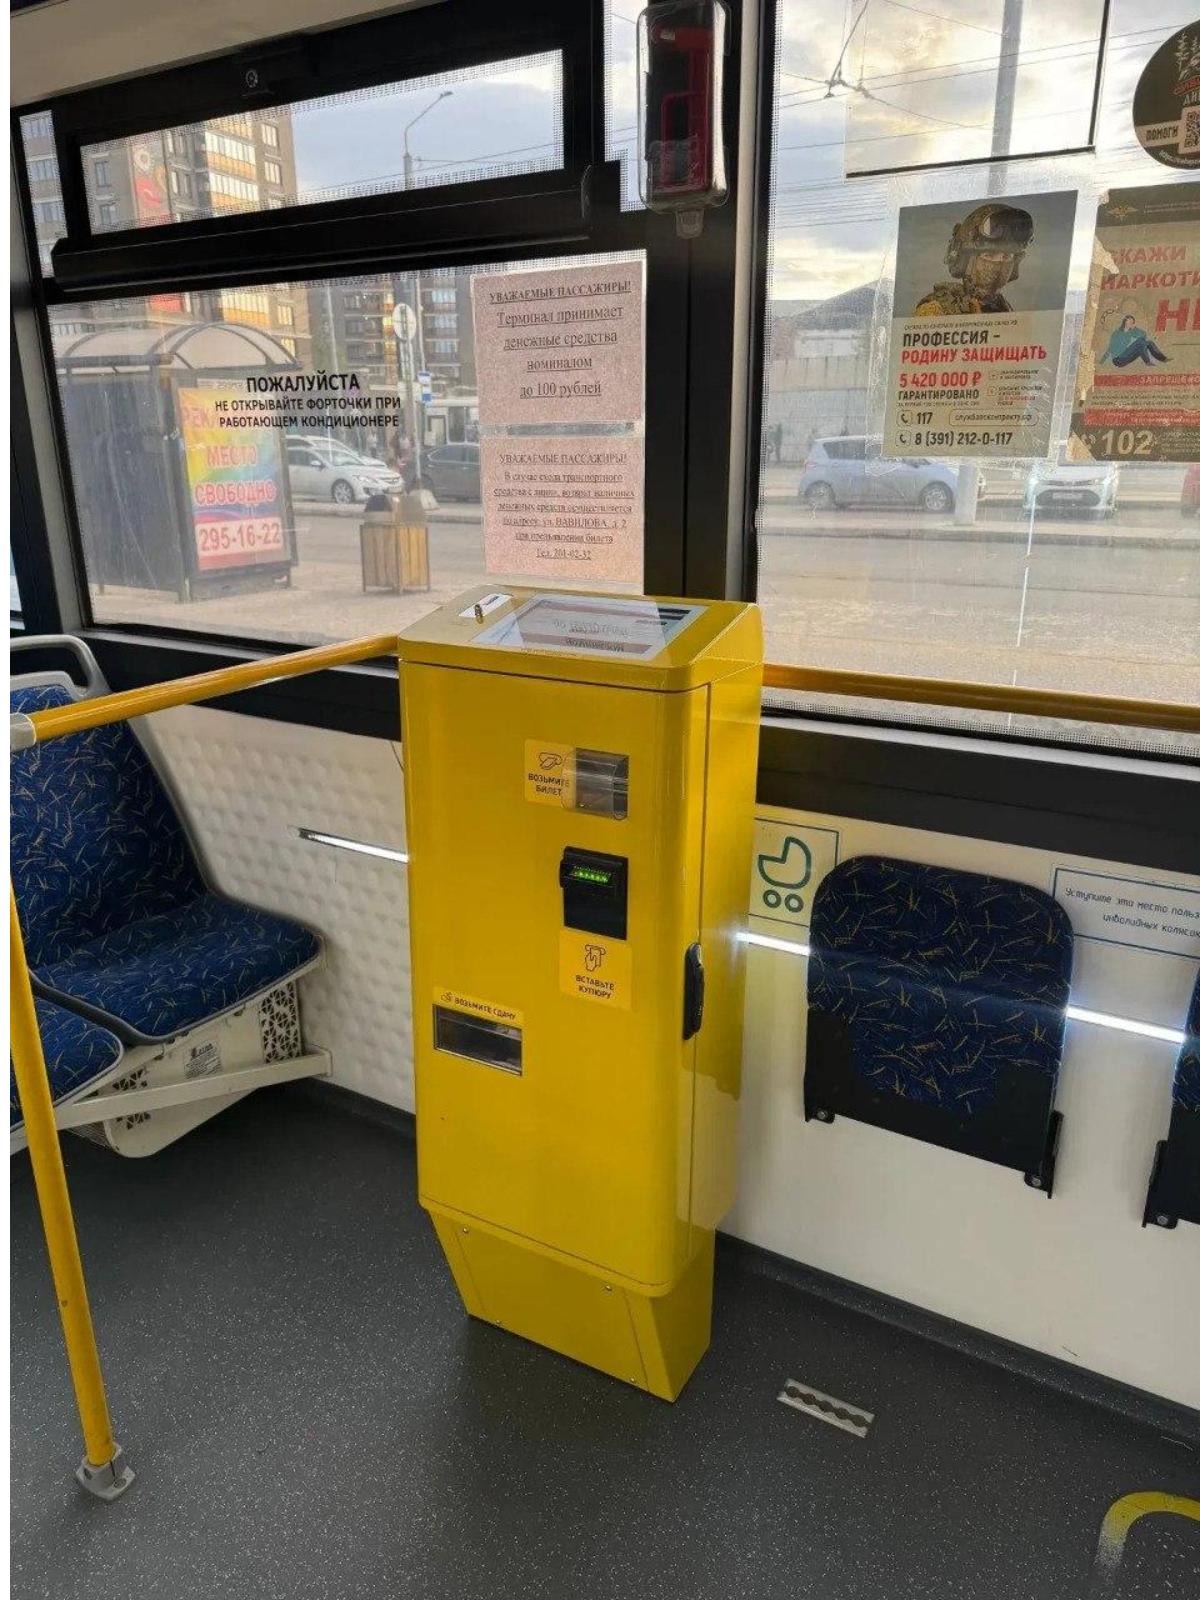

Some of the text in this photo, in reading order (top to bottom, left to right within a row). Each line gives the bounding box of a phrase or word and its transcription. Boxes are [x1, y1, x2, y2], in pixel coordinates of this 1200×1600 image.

[489, 280, 631, 303] УВАЖАЕМЫЕ ПАССАЖИРЫ!
[497, 306, 623, 327] Терминал принимает
[504, 331, 617, 350] денежные средства
[903, 330, 988, 347] ПРОФЕССИЯ
[901, 345, 1047, 365] РОДИНУ ЗАЩИЩАТЬ
[526, 357, 593, 371] номиналом
[247, 370, 360, 393] ПОЖАЛУЙСТА
[899, 374, 907, 388] 5
[911, 372, 937, 387] 420
[941, 372, 968, 386] 000
[520, 381, 601, 398] до 100 рублей
[898, 389, 980, 400] ГАРАНТИРОВАНО
[215, 397, 400, 411] НЕ ОТКРЫВАЙТЕ ФОРТОЧКИ ПРИ
[219, 416, 298, 429] РАБОТАЮЩЕМ
[301, 415, 399, 428] КОНДИЦИОНЕРЕ
[917, 412, 933, 424] 117
[914, 431, 1013, 446] 8 (391) 212-0-117
[1102, 429, 1154, 455] 102
[207, 446, 257, 467] МЕСТО
[194, 482, 276, 504] СВОБОДНО
[200, 523, 280, 550] 295-16-22
[528, 773, 569, 788] ВОЗЬМИТЕ
[536, 784, 561, 796] БИЛЕТ
[1065, 887, 1111, 903] Уступите
[1138, 902, 1168, 914] место
[576, 974, 614, 990] ВСТАВЬТЕ
[579, 986, 611, 1000] КУПЮРУ
[454, 997, 516, 1020] ВОЗЬМИТЕ СДАЧУ
